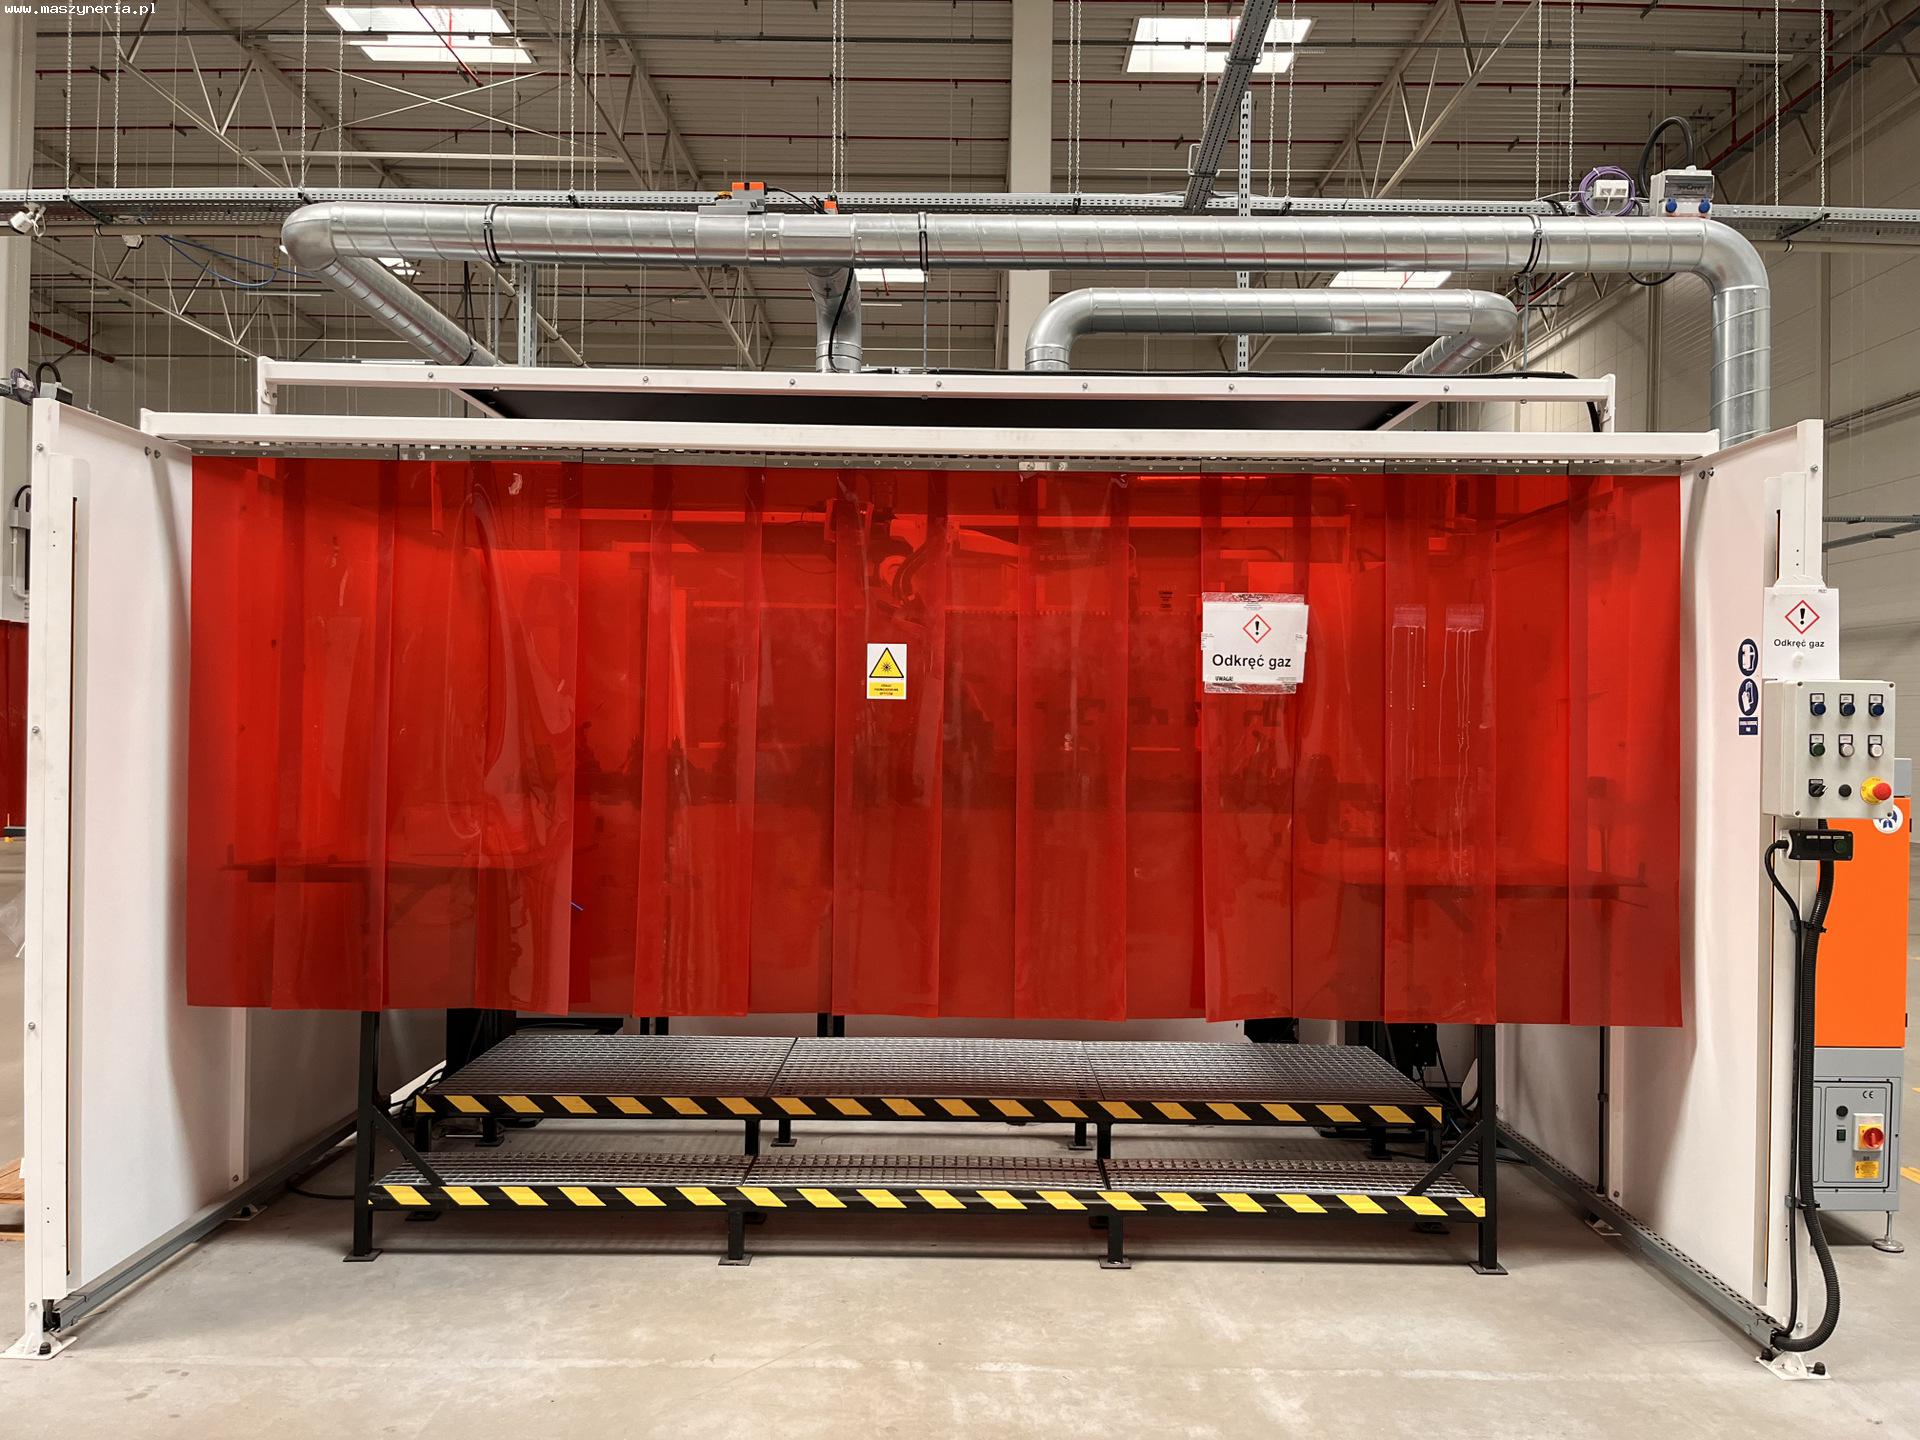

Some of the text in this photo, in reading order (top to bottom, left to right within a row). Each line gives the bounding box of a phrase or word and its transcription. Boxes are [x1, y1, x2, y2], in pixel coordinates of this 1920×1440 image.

[1774, 639, 1825, 649] Odkręć gaz
[1212, 654, 1291, 670] Odkręć gaz
[1863, 1091, 1874, 1099] CE
